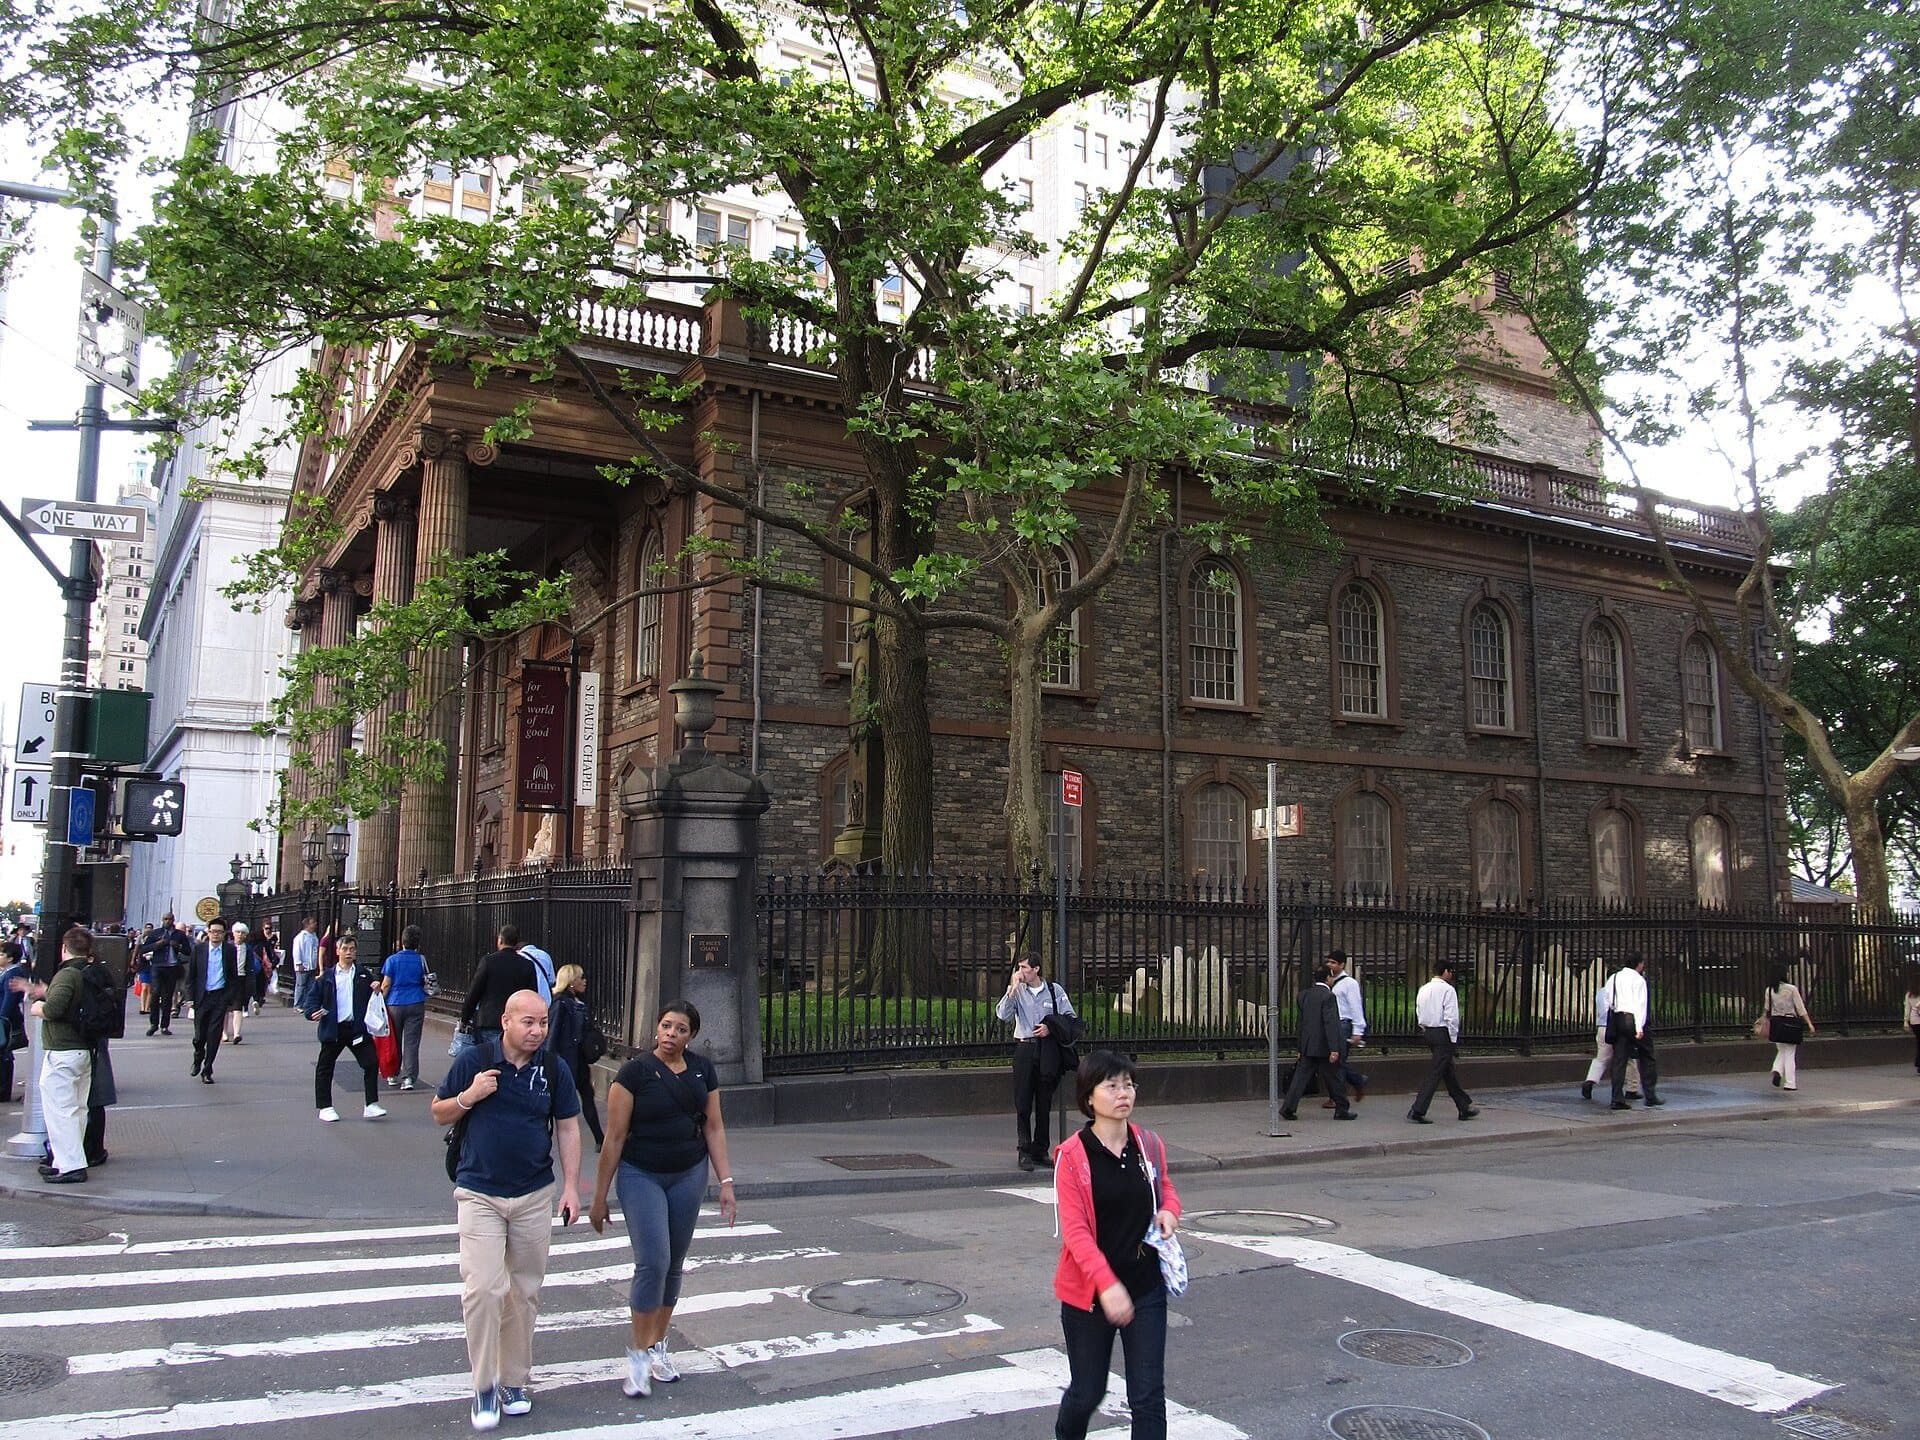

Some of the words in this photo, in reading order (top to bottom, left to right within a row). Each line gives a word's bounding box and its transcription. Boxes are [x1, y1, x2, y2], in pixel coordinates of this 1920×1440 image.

[116, 306, 140, 332] TRUCK
[40, 510, 75, 526] ONE
[93, 514, 128, 530] WAY
[526, 681, 541, 693] for
[585, 684, 595, 700] ST.
[527, 694, 534, 702] a
[527, 704, 555, 715] world
[526, 714, 538, 728] of
[583, 703, 594, 741] PAUL'S
[525, 727, 549, 739] good
[582, 744, 593, 795] CHAPEL
[524, 779, 556, 793] Trinity
[17, 810, 37, 818] ONLY
